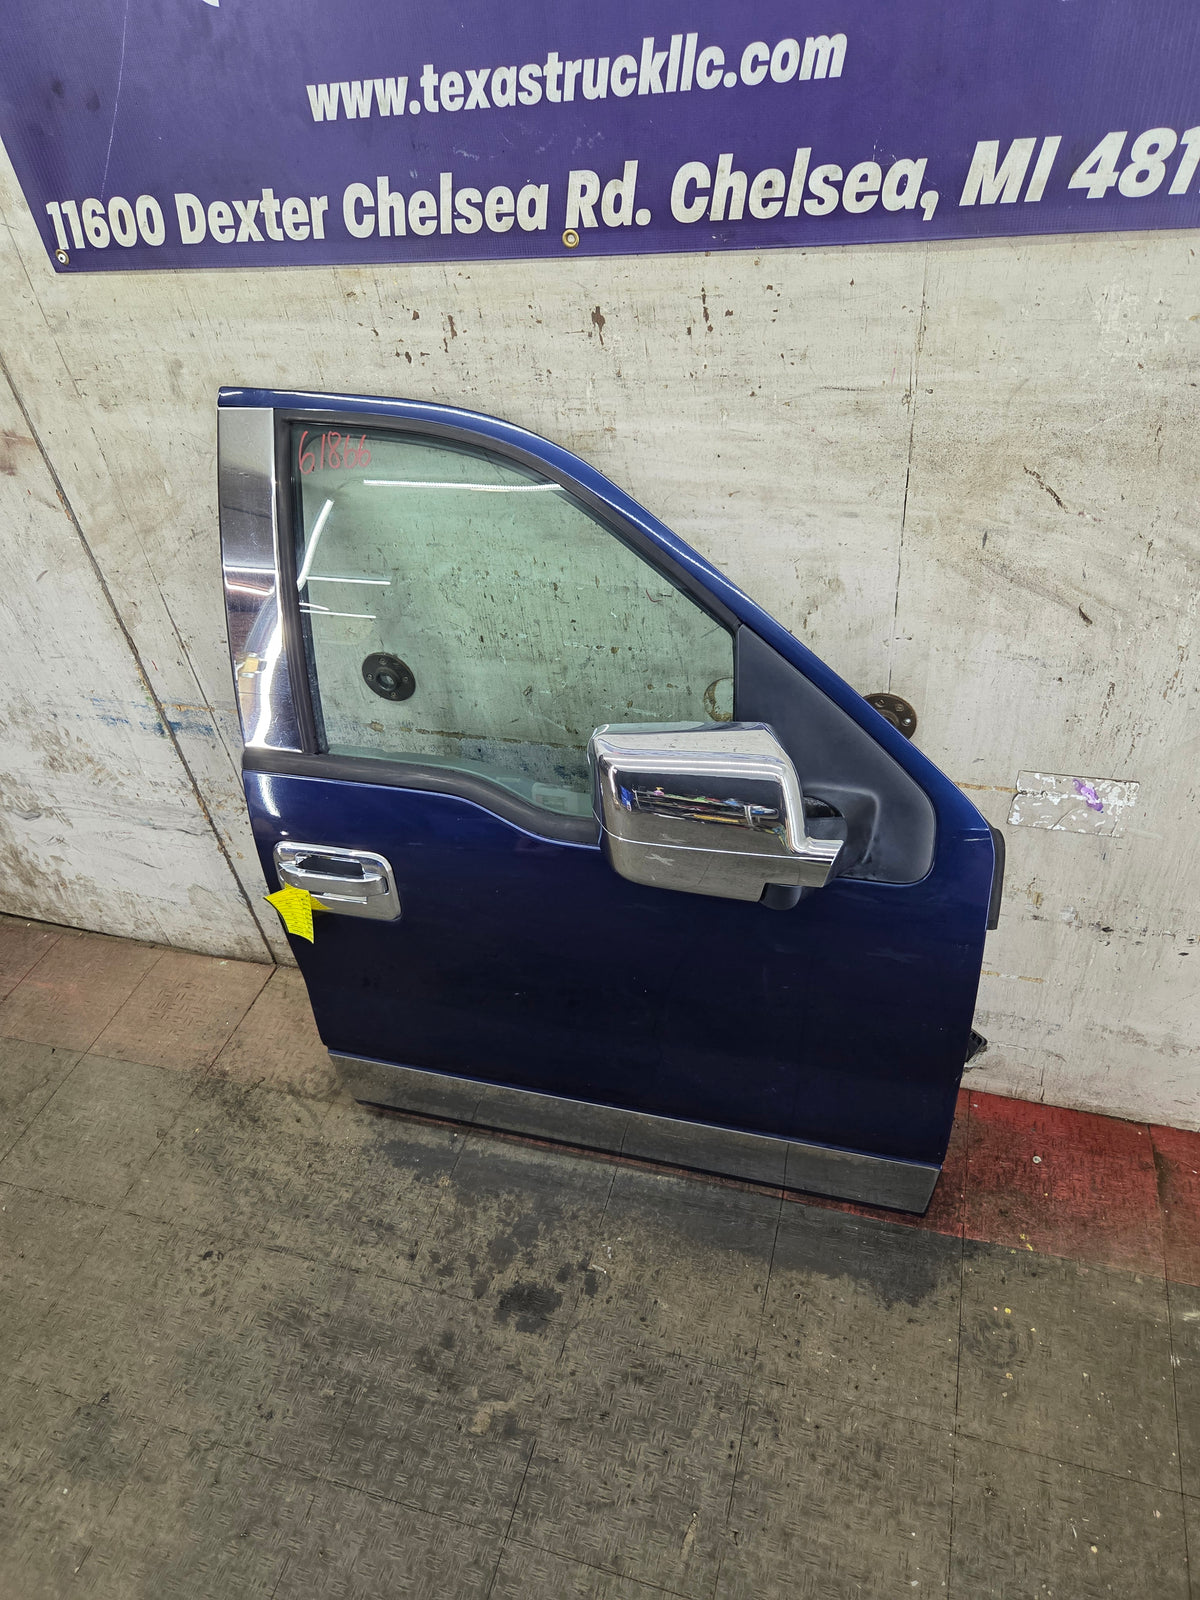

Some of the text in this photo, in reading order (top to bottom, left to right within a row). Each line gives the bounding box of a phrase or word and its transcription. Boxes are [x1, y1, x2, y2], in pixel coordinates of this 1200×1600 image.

[306, 33, 847, 121] www.texastruckllc.com
[46, 125, 1200, 249] 11600 Dexter Chelsea Rd. Chelsea, MI 481
[298, 430, 371, 475] 61866
